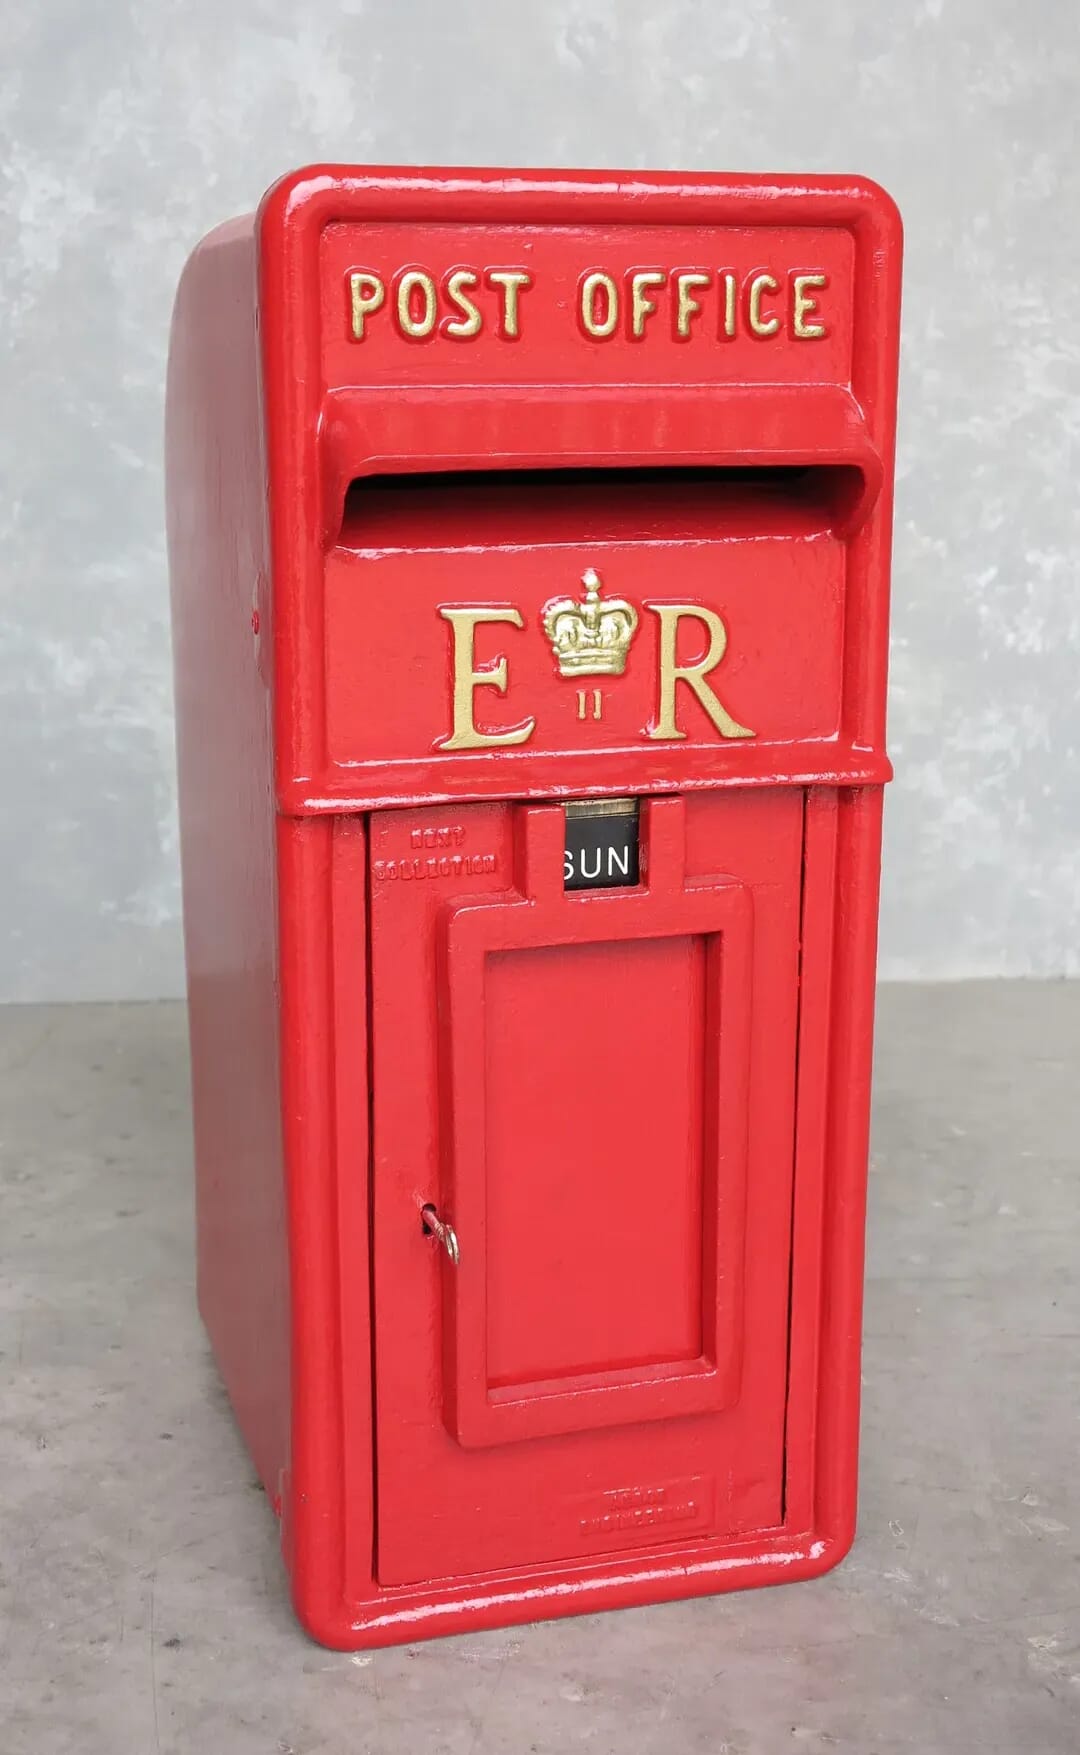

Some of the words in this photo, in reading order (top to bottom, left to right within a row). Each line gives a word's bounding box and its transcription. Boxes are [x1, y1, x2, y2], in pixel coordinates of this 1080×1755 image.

[350, 272, 531, 339] POST
[581, 272, 827, 338] OFFICE
[438, 606, 537, 751] E
[646, 603, 757, 740] R
[564, 845, 629, 881] SUN
